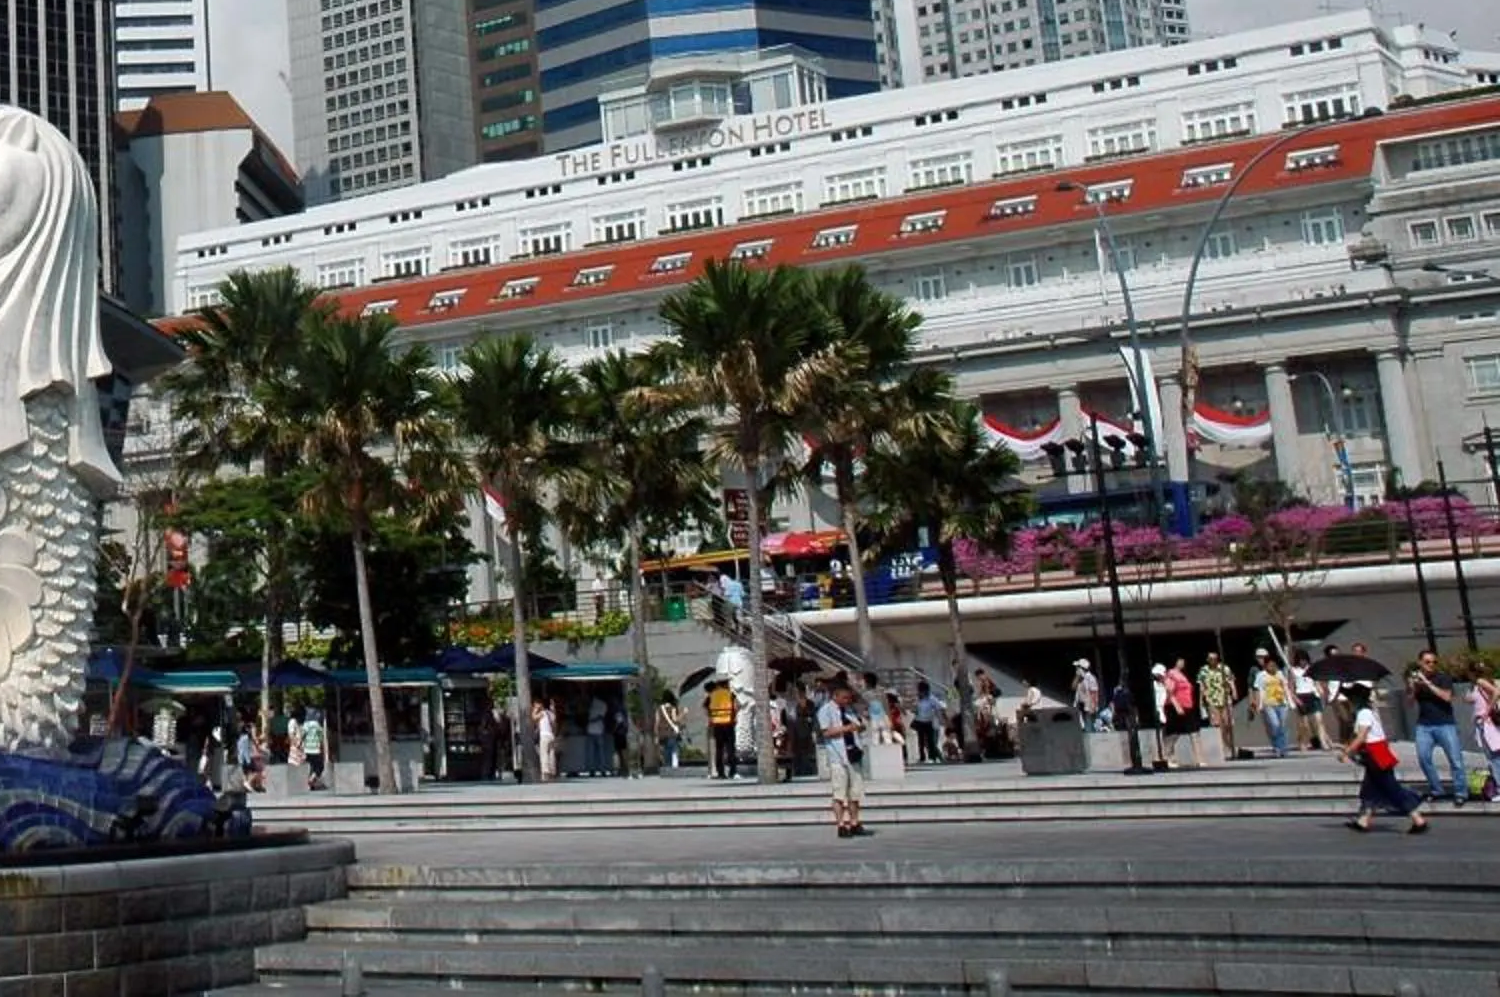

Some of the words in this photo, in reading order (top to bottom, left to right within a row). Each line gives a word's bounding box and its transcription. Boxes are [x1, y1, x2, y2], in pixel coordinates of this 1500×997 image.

[556, 151, 600, 176] THE
[611, 124, 744, 168] FULLERTON
[753, 107, 832, 140] HOTEL
